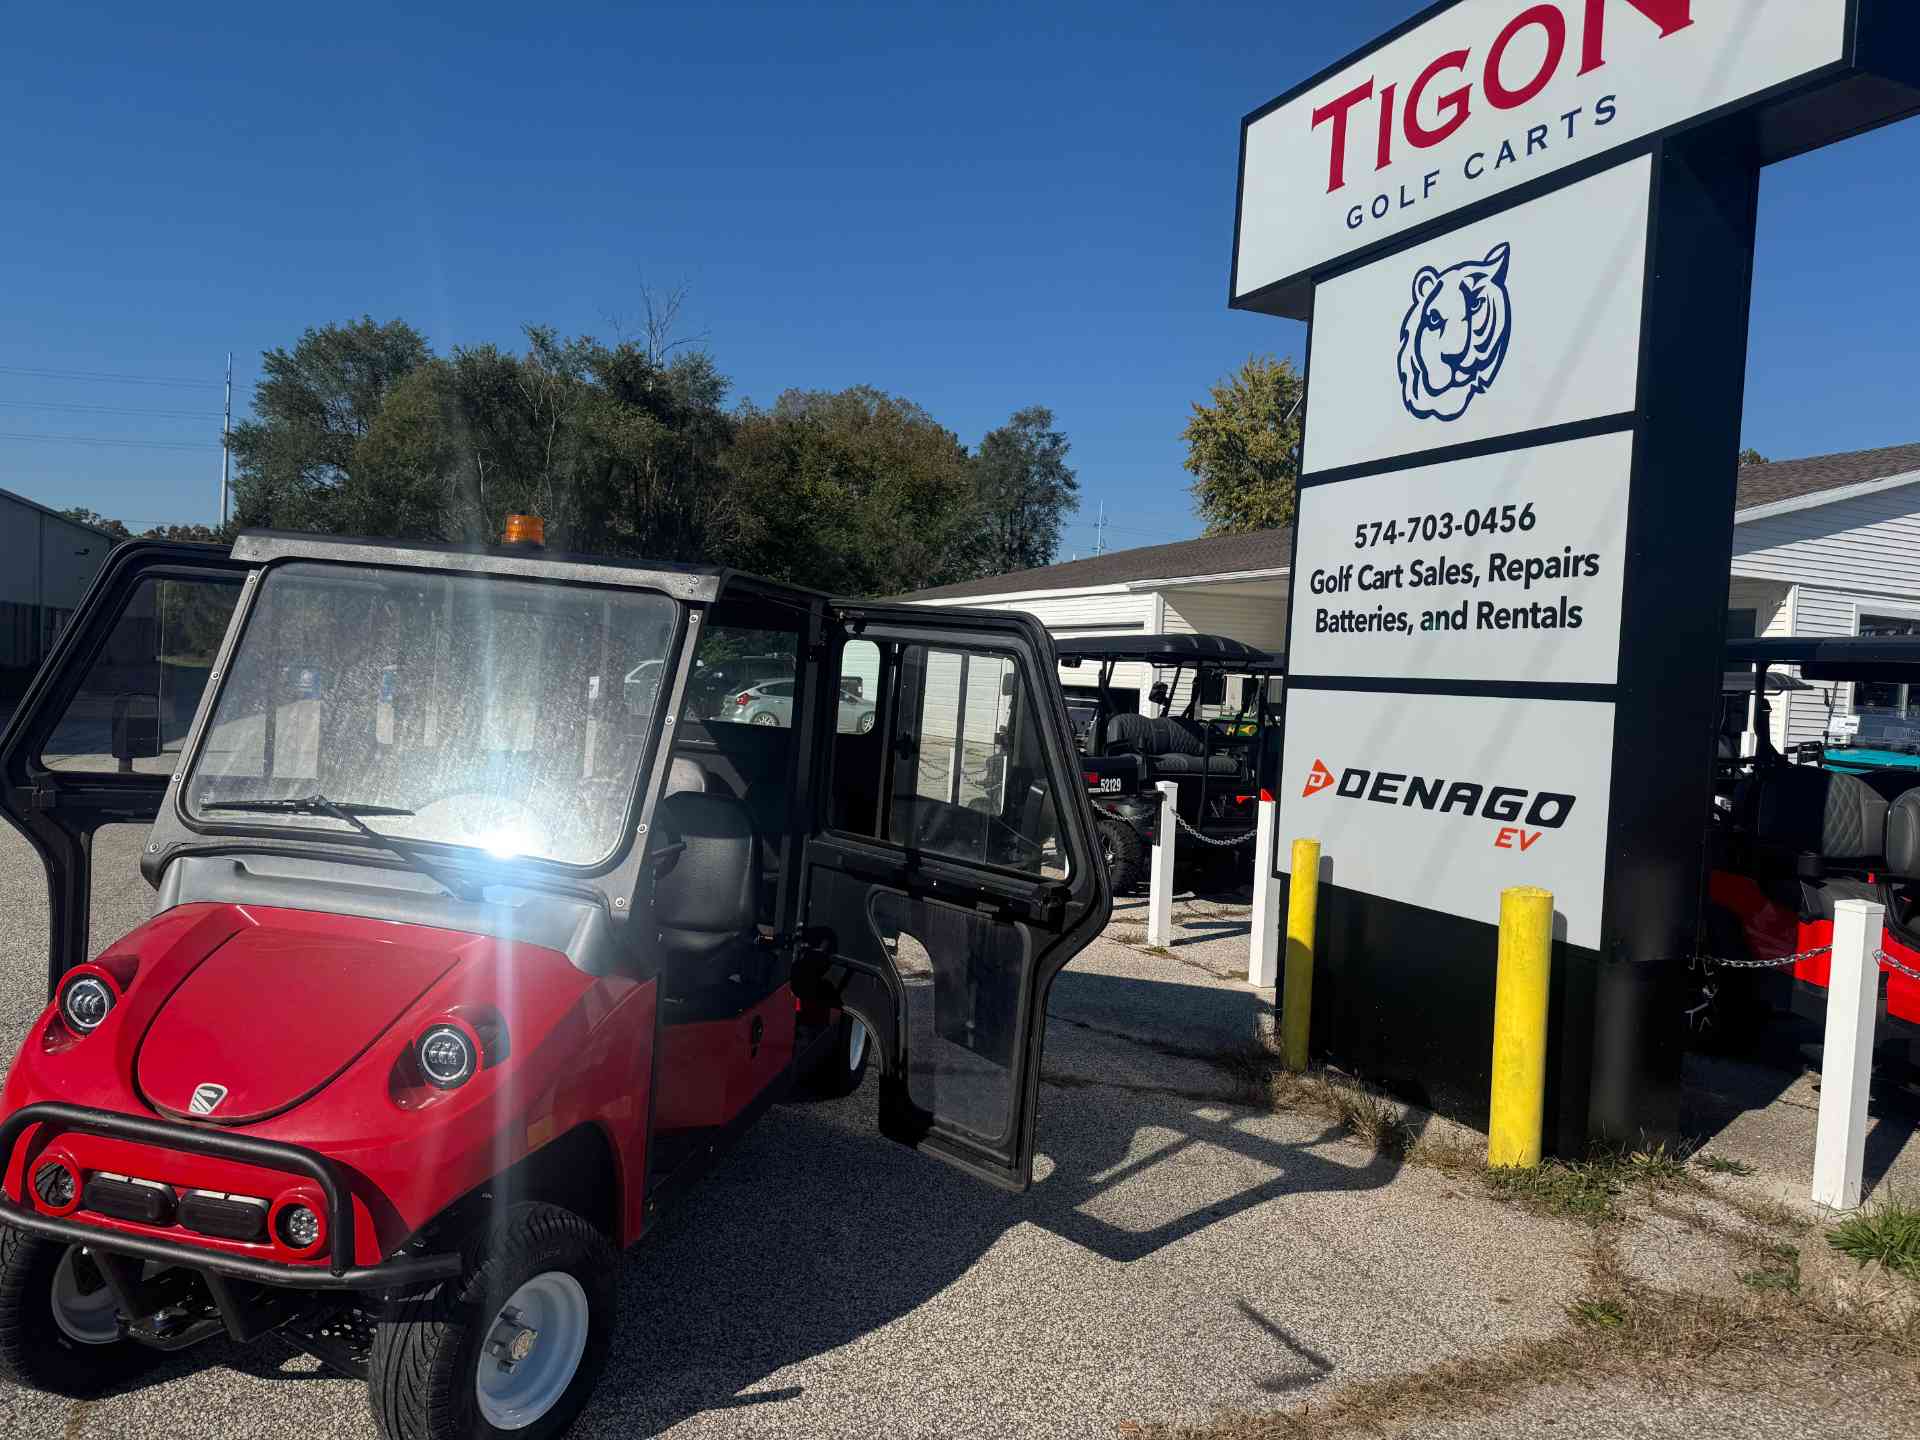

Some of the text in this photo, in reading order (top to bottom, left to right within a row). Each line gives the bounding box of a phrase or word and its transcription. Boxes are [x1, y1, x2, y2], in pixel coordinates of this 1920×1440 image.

[1347, 94, 1617, 230] GOLF CARTS
[1354, 502, 1537, 549] 574-703-0456
[1310, 545, 1601, 595] Golf Cart Sales, Repairs
[1315, 595, 1584, 636] Batteries, and Rentals
[1335, 767, 1577, 829] DENAGO
[1494, 826, 1543, 852] EV
